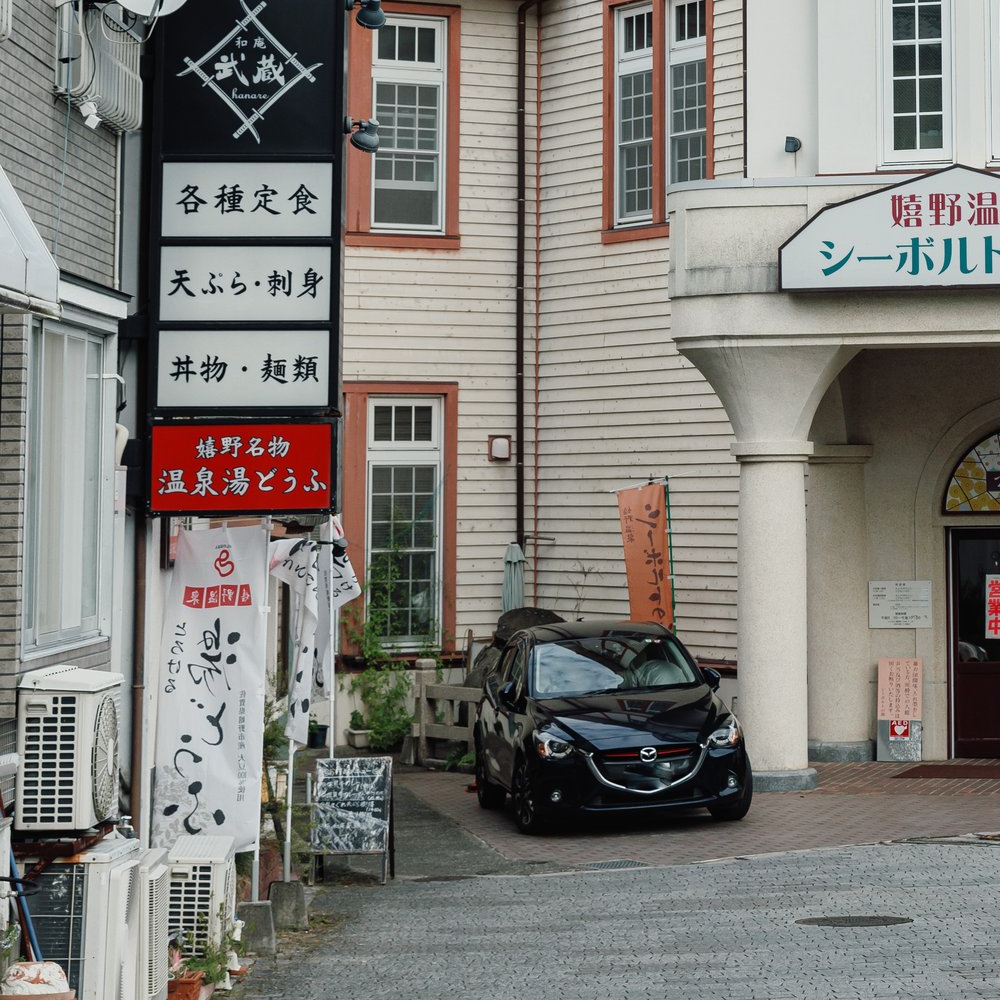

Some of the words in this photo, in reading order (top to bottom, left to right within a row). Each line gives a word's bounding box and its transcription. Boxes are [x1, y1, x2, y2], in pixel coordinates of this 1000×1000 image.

[235, 36, 267, 49] 和庵
[214, 52, 286, 86] 武蔵
[231, 88, 270, 100] hanare
[176, 184, 319, 215] 各種定食
[167, 267, 324, 298] 天ぷら・刺身
[195, 436, 291, 459] 嬉野名物
[157, 466, 328, 497] 温泉湯どうふ
